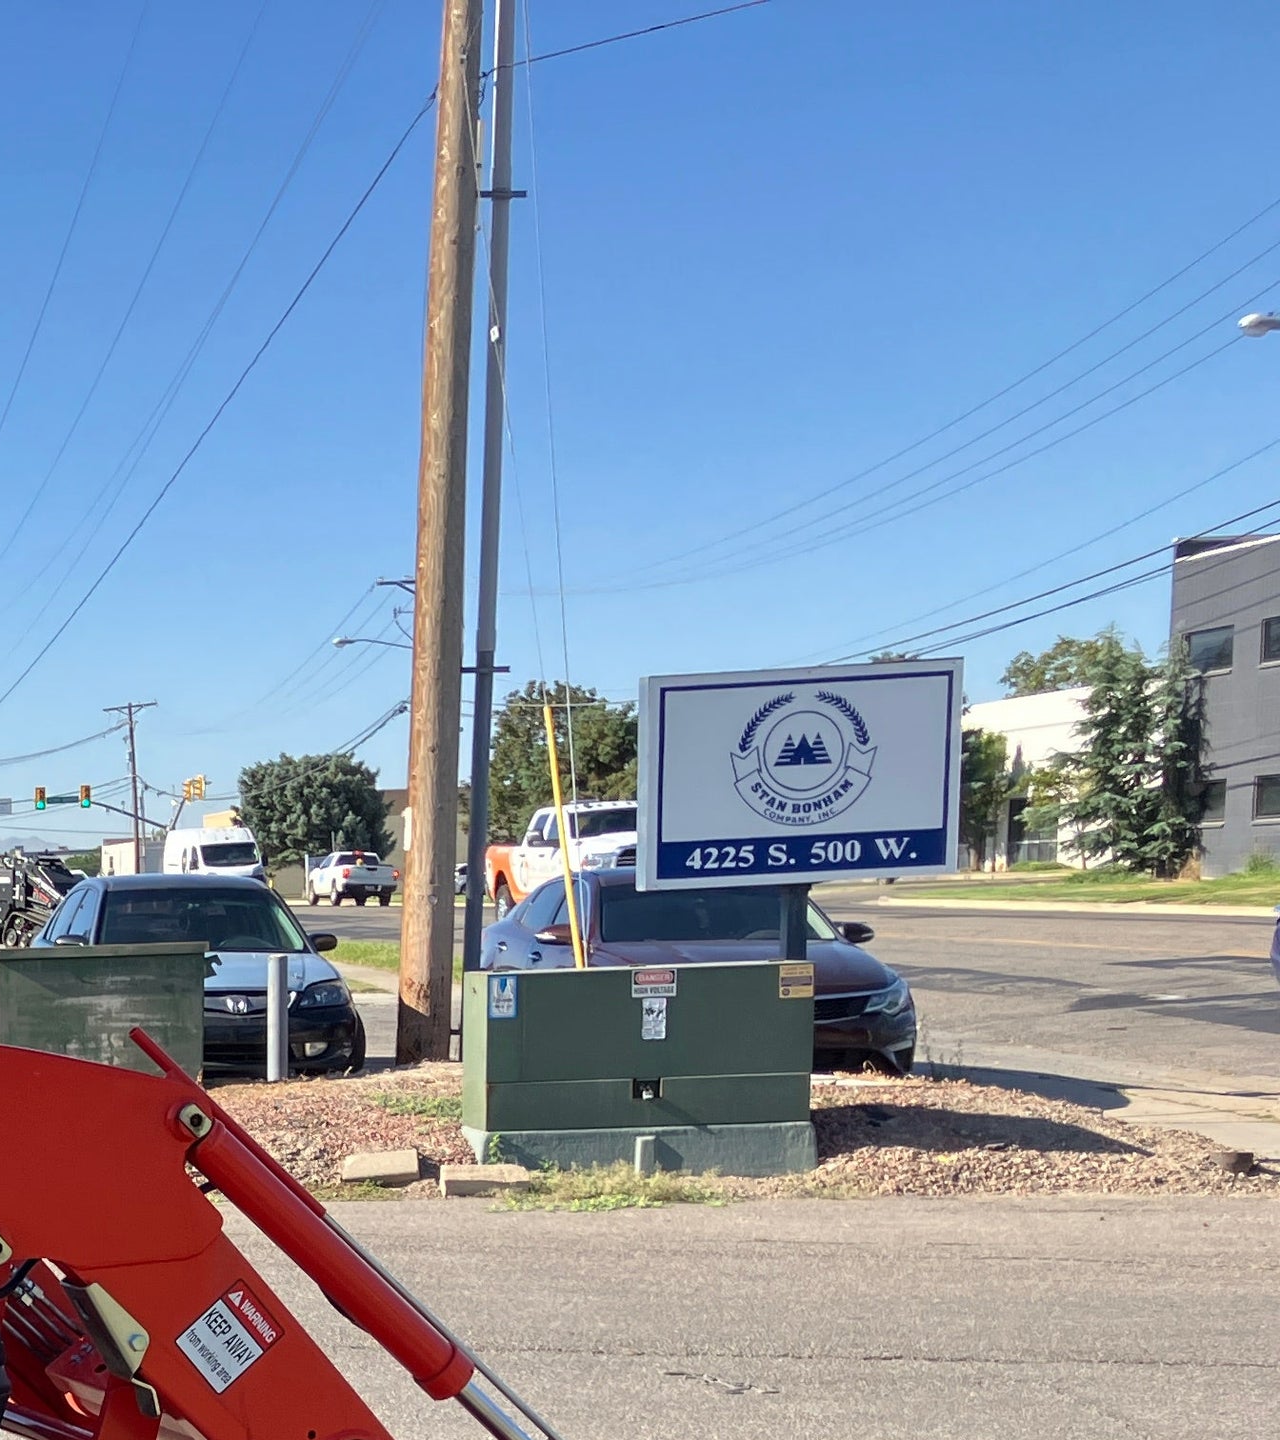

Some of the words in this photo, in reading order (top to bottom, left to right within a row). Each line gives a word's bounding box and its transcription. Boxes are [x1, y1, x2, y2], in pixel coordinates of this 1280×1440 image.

[750, 781, 788, 813] STAN
[792, 777, 854, 814] BONHAM
[685, 844, 756, 870] 4225
[767, 842, 797, 867] S.
[810, 840, 861, 865] 500
[874, 837, 918, 861] W.
[202, 1307, 232, 1338] KEEP
[222, 1333, 256, 1367] AWAY
[239, 1298, 277, 1344] WARNING
[185, 1327, 202, 1350] from
[196, 1344, 221, 1373] working
[215, 1364, 233, 1385] area
